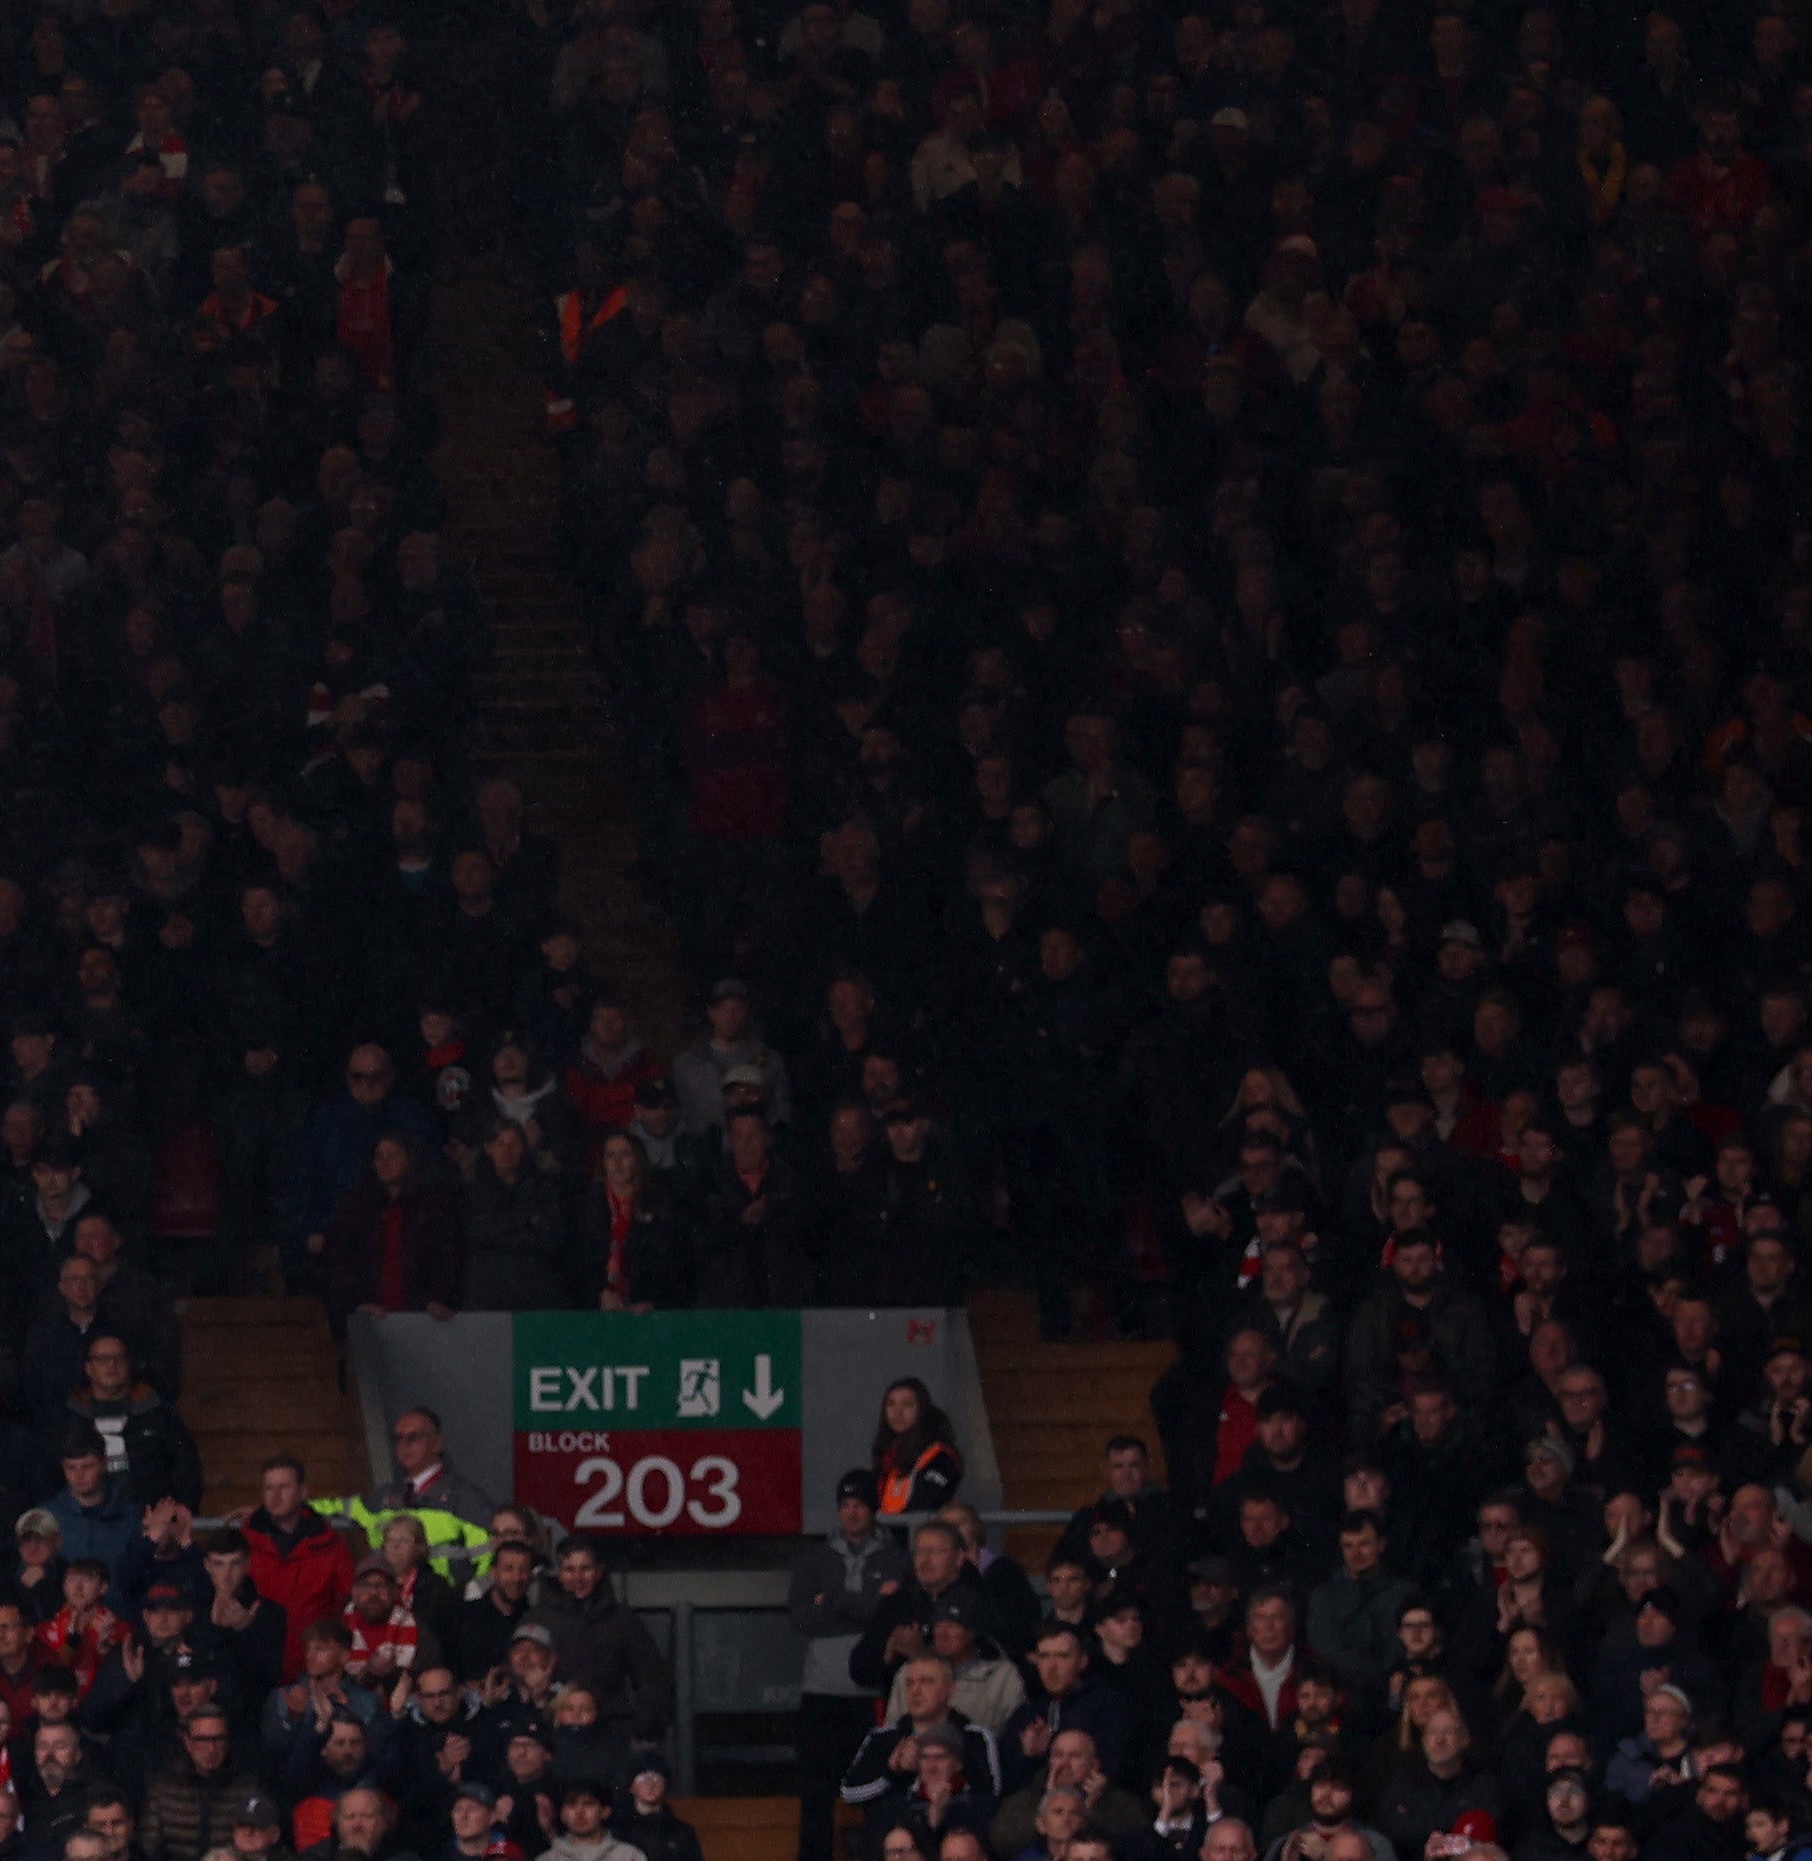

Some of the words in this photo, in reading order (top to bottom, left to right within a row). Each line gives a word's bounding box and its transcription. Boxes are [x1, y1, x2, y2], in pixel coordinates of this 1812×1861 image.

[529, 1367, 651, 1411] EXIT
[527, 1431, 610, 1452] BLOCK
[574, 1455, 742, 1529] 203
